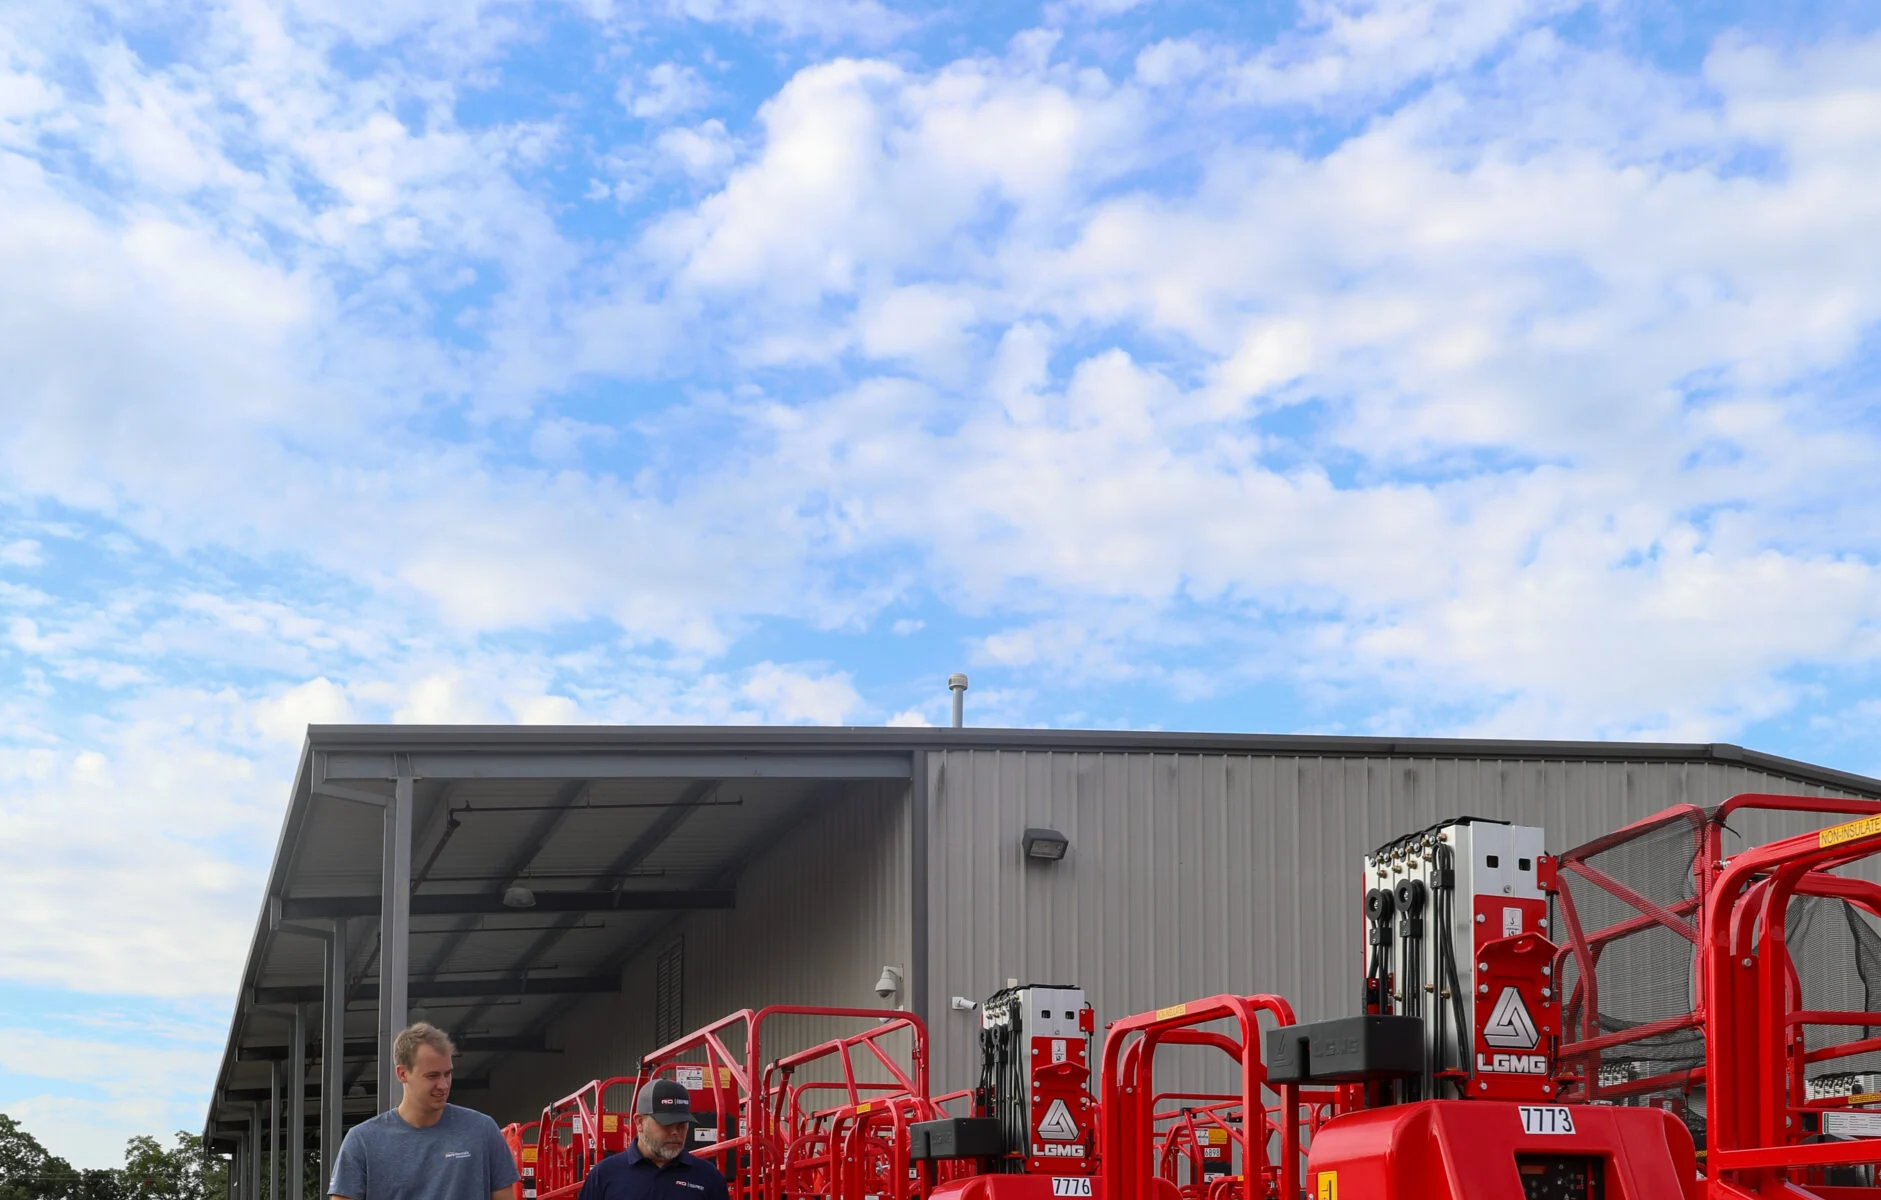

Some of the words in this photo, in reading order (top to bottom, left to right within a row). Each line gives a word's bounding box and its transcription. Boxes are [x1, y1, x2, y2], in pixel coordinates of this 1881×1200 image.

[1477, 1053, 1547, 1075] LGMG
[1521, 1108, 1572, 1132] 7773
[1033, 1144, 1085, 1158] LGMG
[1054, 1178, 1090, 1195] 7776
